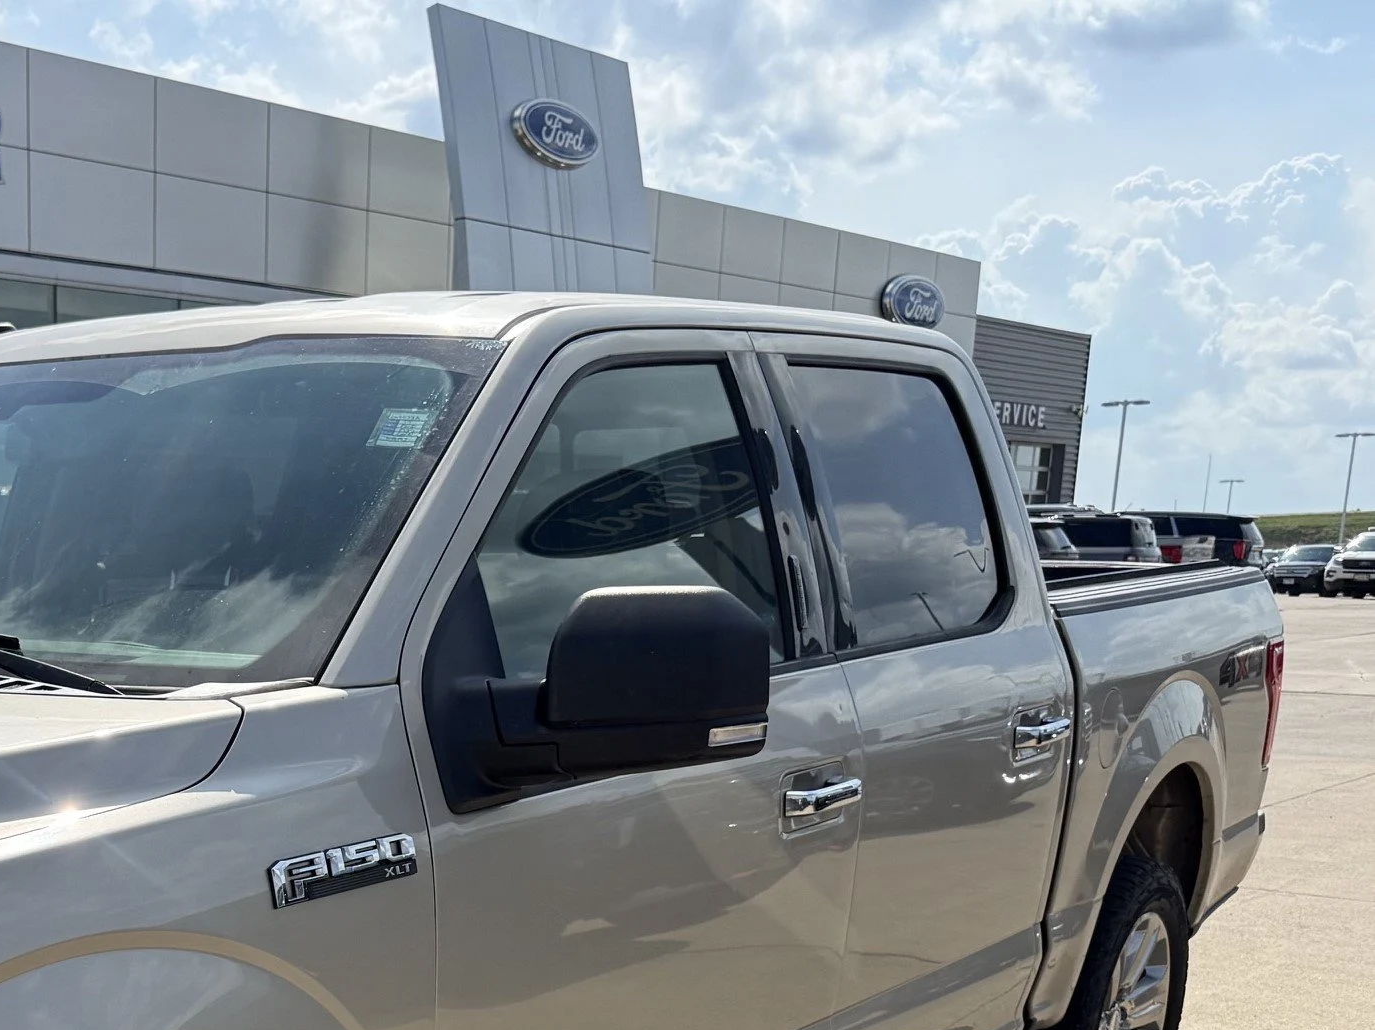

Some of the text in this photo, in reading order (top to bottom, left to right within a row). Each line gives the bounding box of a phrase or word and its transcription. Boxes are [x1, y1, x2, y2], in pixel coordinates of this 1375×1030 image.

[542, 111, 586, 152] Ford
[905, 287, 938, 322] Ford
[993, 401, 1046, 428] ERVICE
[384, 862, 412, 878] XLT
